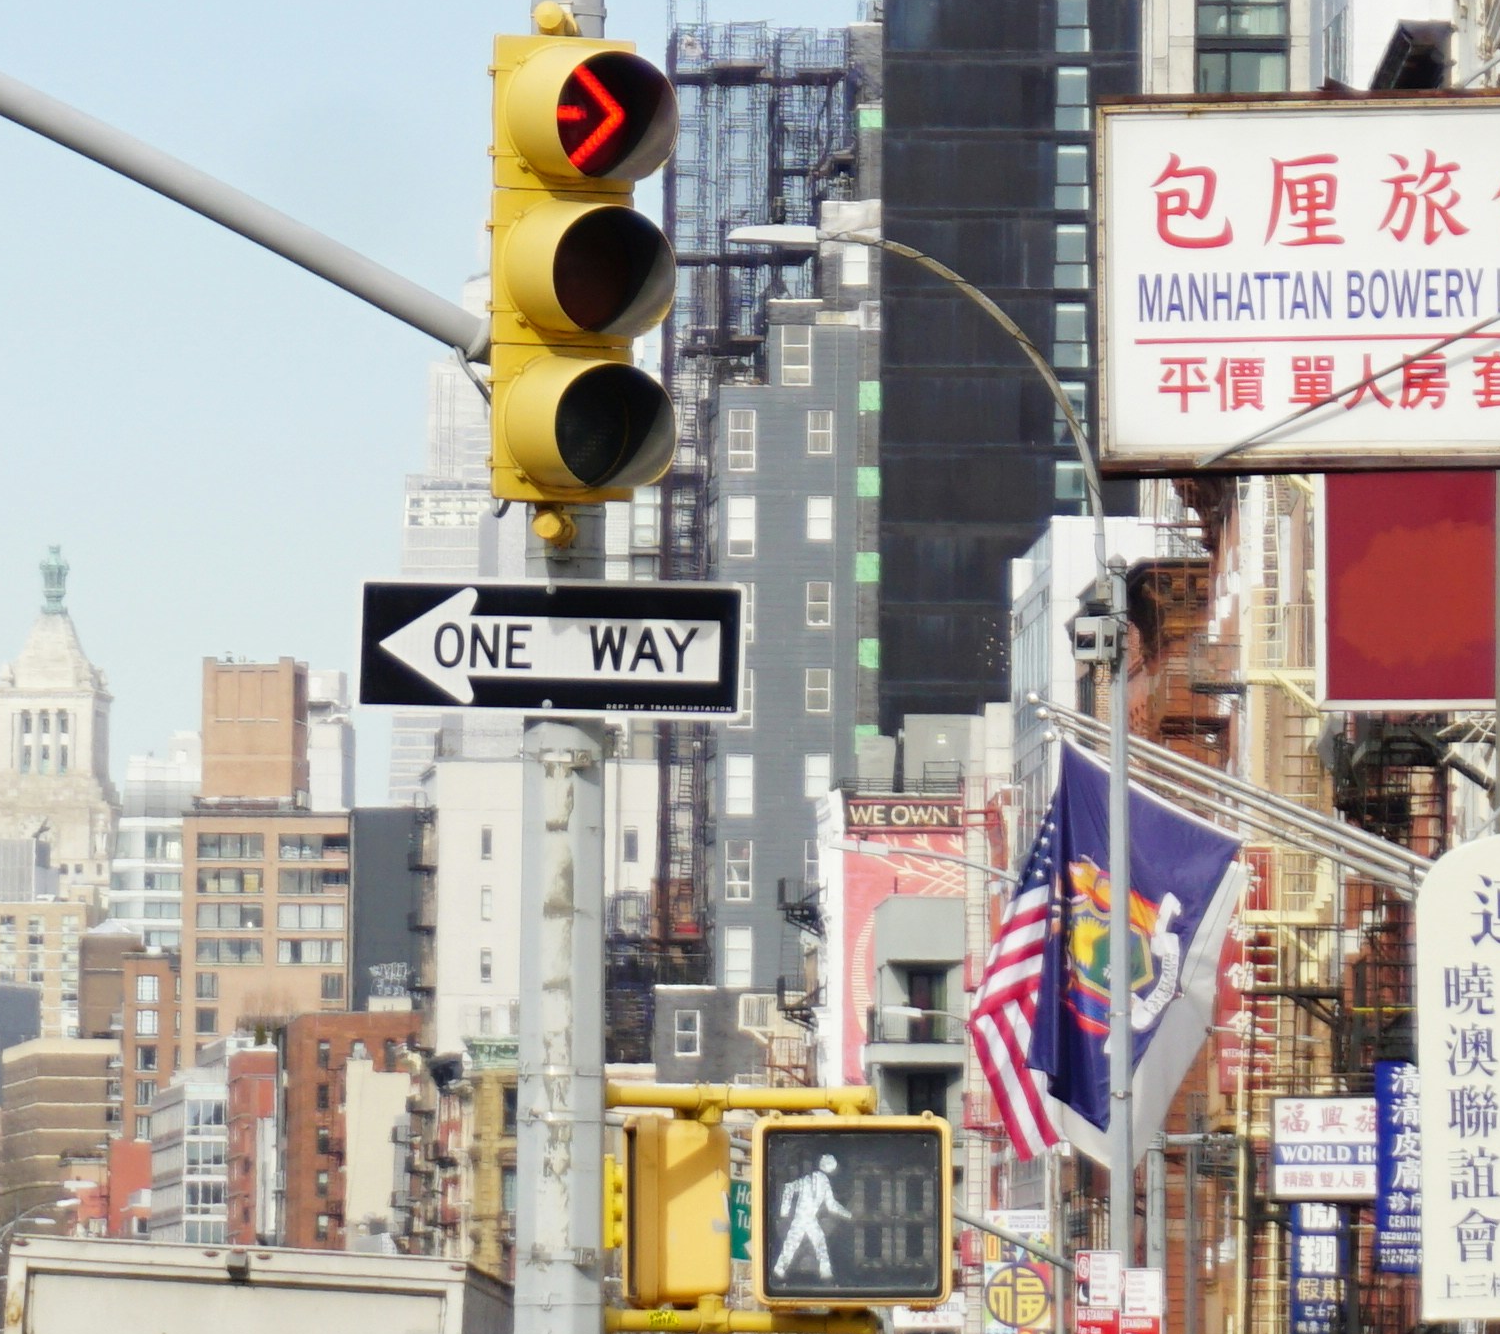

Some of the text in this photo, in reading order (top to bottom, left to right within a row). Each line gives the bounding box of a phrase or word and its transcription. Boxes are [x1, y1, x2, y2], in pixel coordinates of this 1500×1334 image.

[1137, 270, 1333, 323] MANHATTAN
[1346, 269, 1485, 319] BOWERY
[1158, 356, 1266, 414] 平價
[1288, 354, 1451, 412] 單人房
[433, 623, 700, 674] ONE WAY
[650, 704, 732, 712] TRANSPORTATION
[850, 804, 886, 825] WE
[891, 804, 949, 825] OWN
[1280, 1144, 1351, 1163] WORLD
